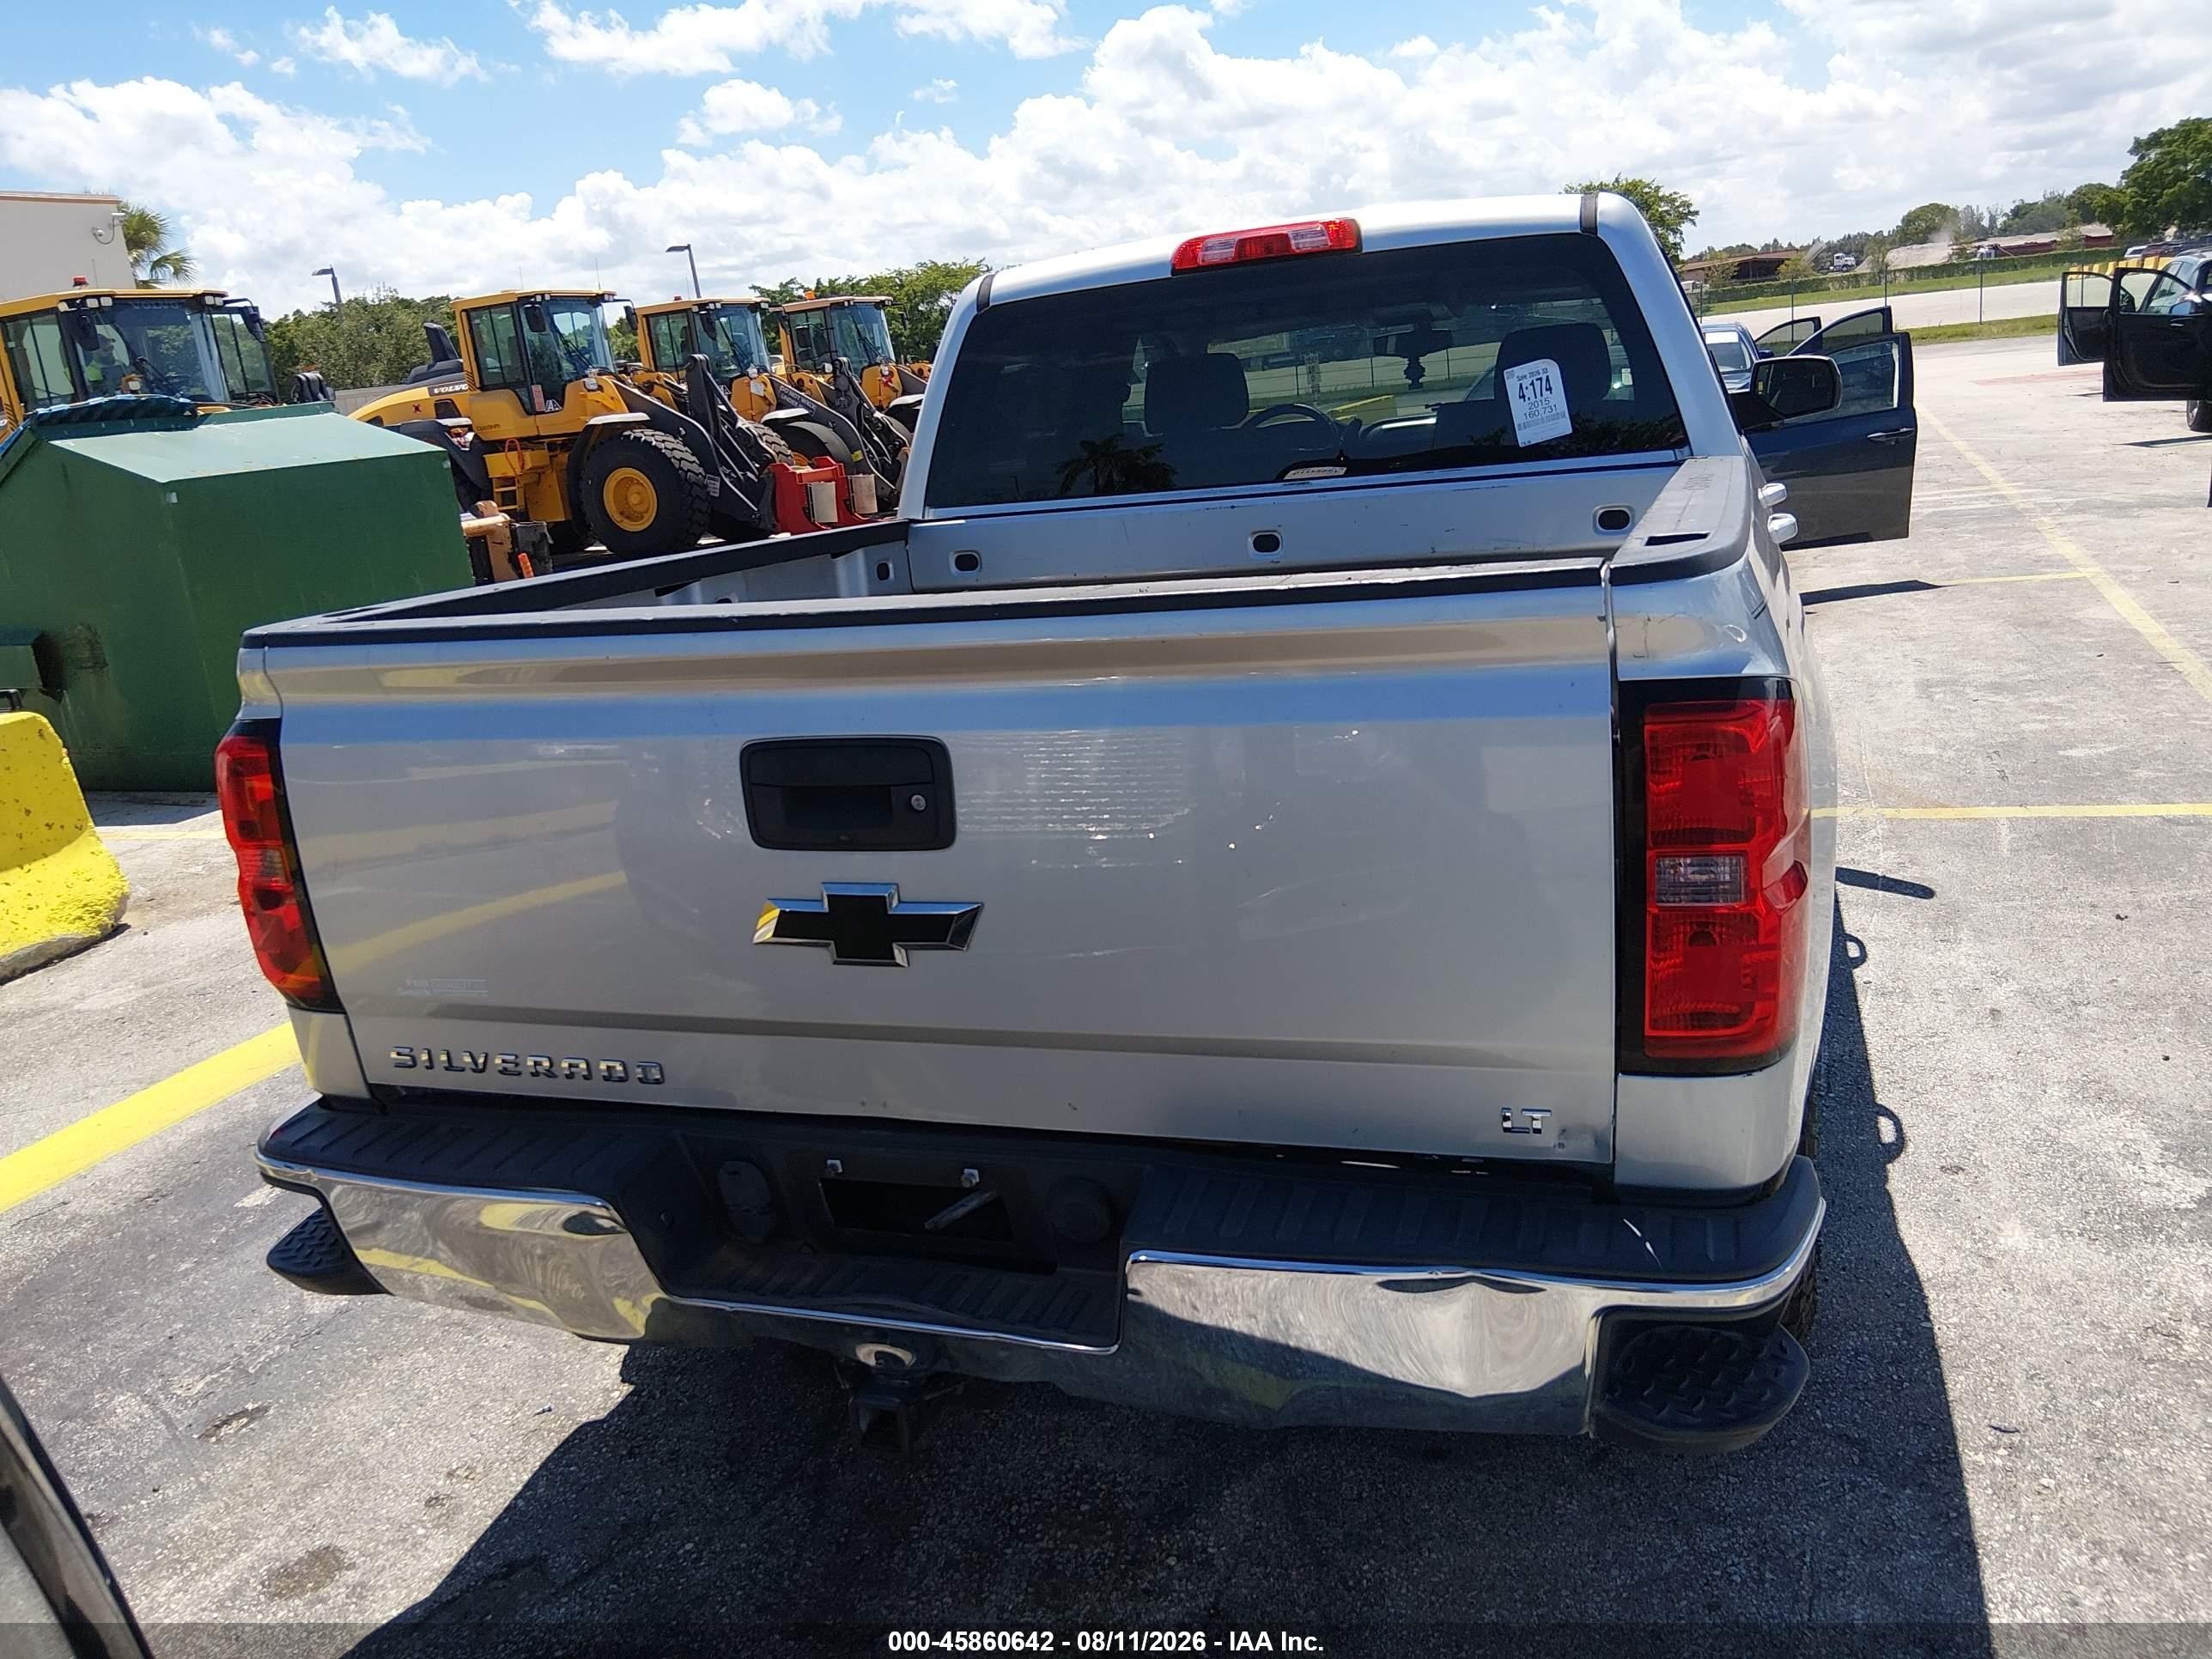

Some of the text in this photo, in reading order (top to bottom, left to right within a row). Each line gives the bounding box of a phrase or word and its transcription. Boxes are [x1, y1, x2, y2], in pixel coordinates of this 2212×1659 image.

[1518, 374, 1553, 403] 4:174
[1528, 397, 1550, 410] 2015
[389, 1045, 666, 1085] SILVERADO
[1501, 1107, 1553, 1134] LT
